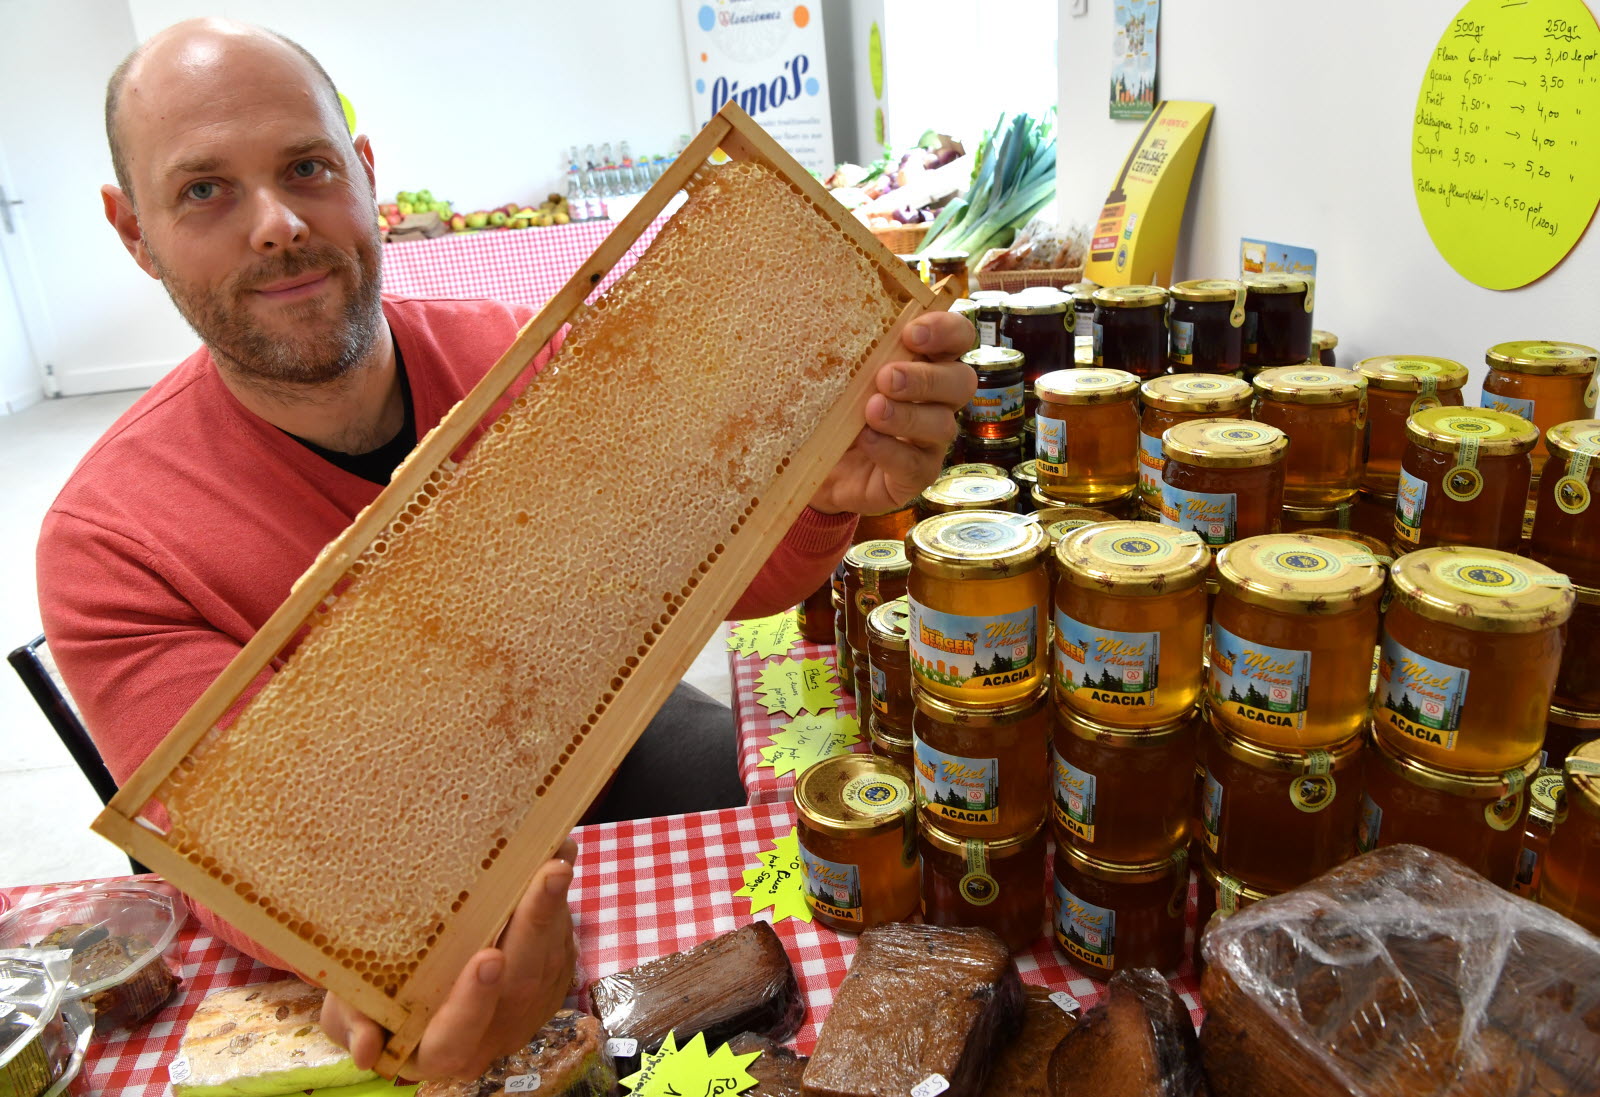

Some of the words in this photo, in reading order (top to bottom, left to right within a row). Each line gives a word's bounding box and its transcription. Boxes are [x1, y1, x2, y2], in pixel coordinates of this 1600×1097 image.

[1455, 19, 1485, 43] 500gr
[1545, 19, 1578, 43] 250gr
[1544, 48, 1569, 66] 3,10
[1463, 69, 1483, 90] 6,50
[1540, 74, 1564, 93] 3,50
[1461, 94, 1480, 112] 7,50
[1537, 101, 1560, 123] 4,00
[1458, 116, 1479, 136] 7,50
[1416, 136, 1443, 163] Sapin
[1532, 128, 1556, 151] 4,00
[1525, 160, 1551, 179] 5,20
[1504, 196, 1526, 212] 6,50
[1526, 202, 1543, 222] pot
[1186, 498, 1226, 514] Miel
[985, 618, 1029, 639] Miel
[921, 631, 974, 651] BERGER
[1094, 637, 1147, 656] Miel
[1243, 650, 1295, 675] Miel
[806, 668, 820, 690] Fleurs
[982, 669, 1030, 687] ACACIA
[1401, 657, 1452, 690] Miel
[1091, 691, 1146, 706] ACACIA
[1237, 705, 1293, 727] ACACIA
[1390, 714, 1442, 745] ACACIA
[941, 760, 986, 779] Miel
[1056, 759, 1085, 790] Miel
[941, 807, 989, 822] ACACIA
[768, 854, 780, 869] pot
[812, 860, 848, 882] Miel
[815, 901, 853, 919] ACACIA
[1066, 897, 1103, 925] Miel
[1063, 939, 1104, 966] ACACIA
